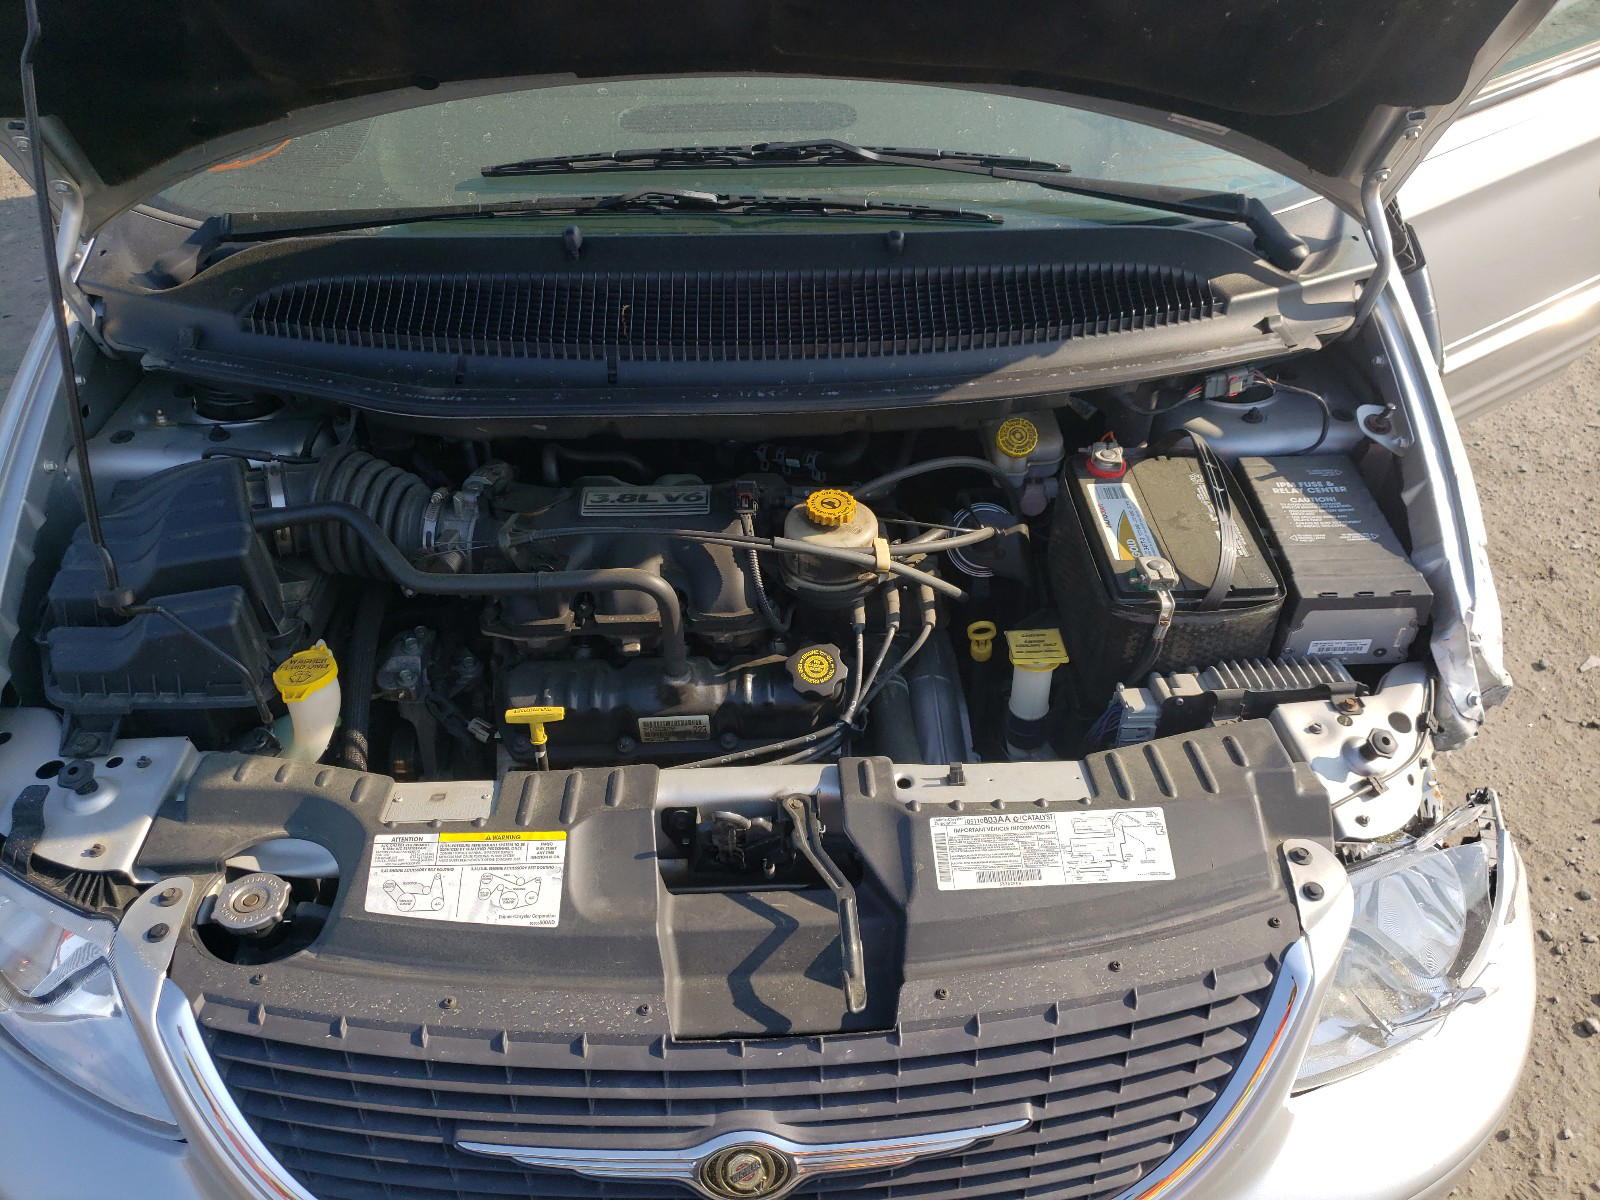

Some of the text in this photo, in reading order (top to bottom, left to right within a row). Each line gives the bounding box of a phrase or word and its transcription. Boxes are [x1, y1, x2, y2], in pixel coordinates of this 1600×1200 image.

[1307, 486, 1347, 494] CENTER
[590, 491, 704, 503] 3.8L V6
[1126, 538, 1141, 558] GOLD
[290, 657, 328, 665] WASHER
[1022, 813, 1054, 821] CATALYST
